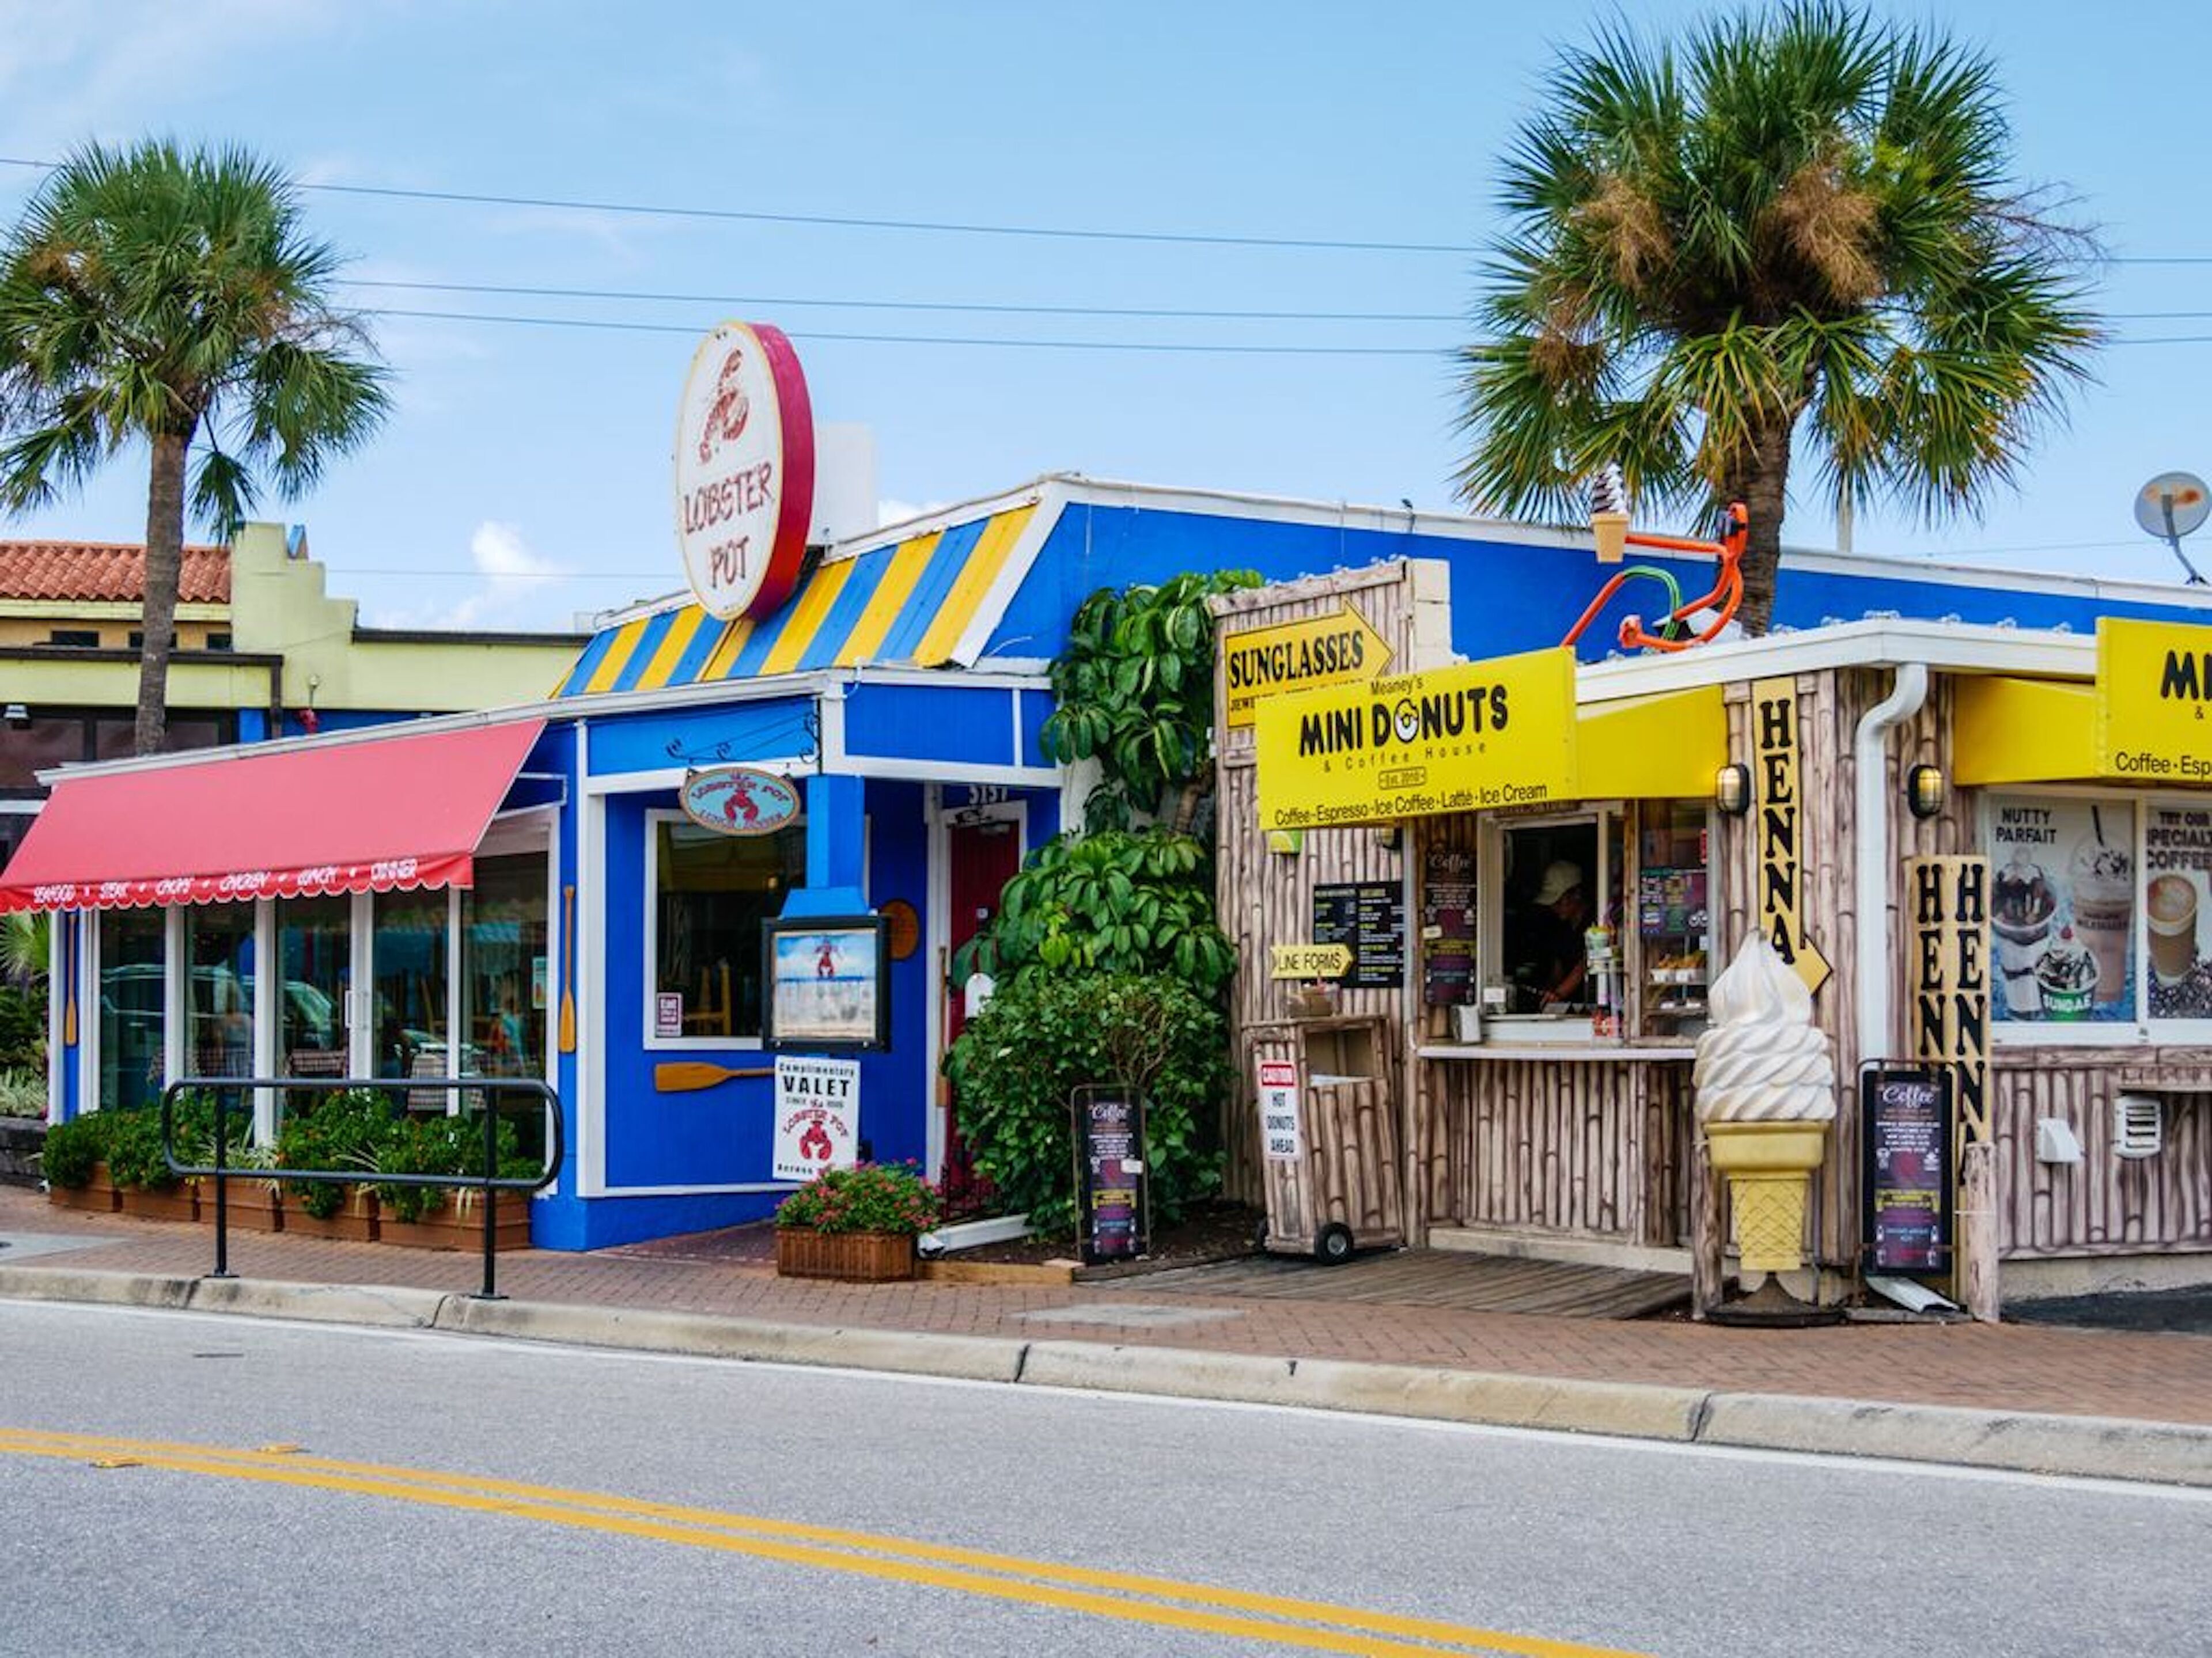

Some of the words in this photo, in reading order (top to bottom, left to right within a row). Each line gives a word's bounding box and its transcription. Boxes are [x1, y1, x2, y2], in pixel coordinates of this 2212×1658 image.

[684, 461, 773, 534] LOBSTER
[709, 536, 750, 589] POT
[1229, 629, 1364, 689] SUNGLASSES
[1370, 675, 1423, 695] Meaney's
[1300, 708, 1363, 757] MINI
[1372, 685, 1508, 752] DONUTS
[2195, 706, 2204, 719] &
[1345, 751, 1410, 771] Coffee
[1425, 741, 1487, 760] House
[1503, 783, 1548, 801] Cream
[2002, 809, 2051, 825] NUTTY
[1760, 699, 1796, 964] HENNA
[1996, 828, 2056, 844] PARFAIT
[1278, 953, 1301, 971] LINE
[1305, 951, 1342, 970] FORMS
[783, 1076, 850, 1097] VALET
[1883, 1084, 1935, 1109] Coffee
